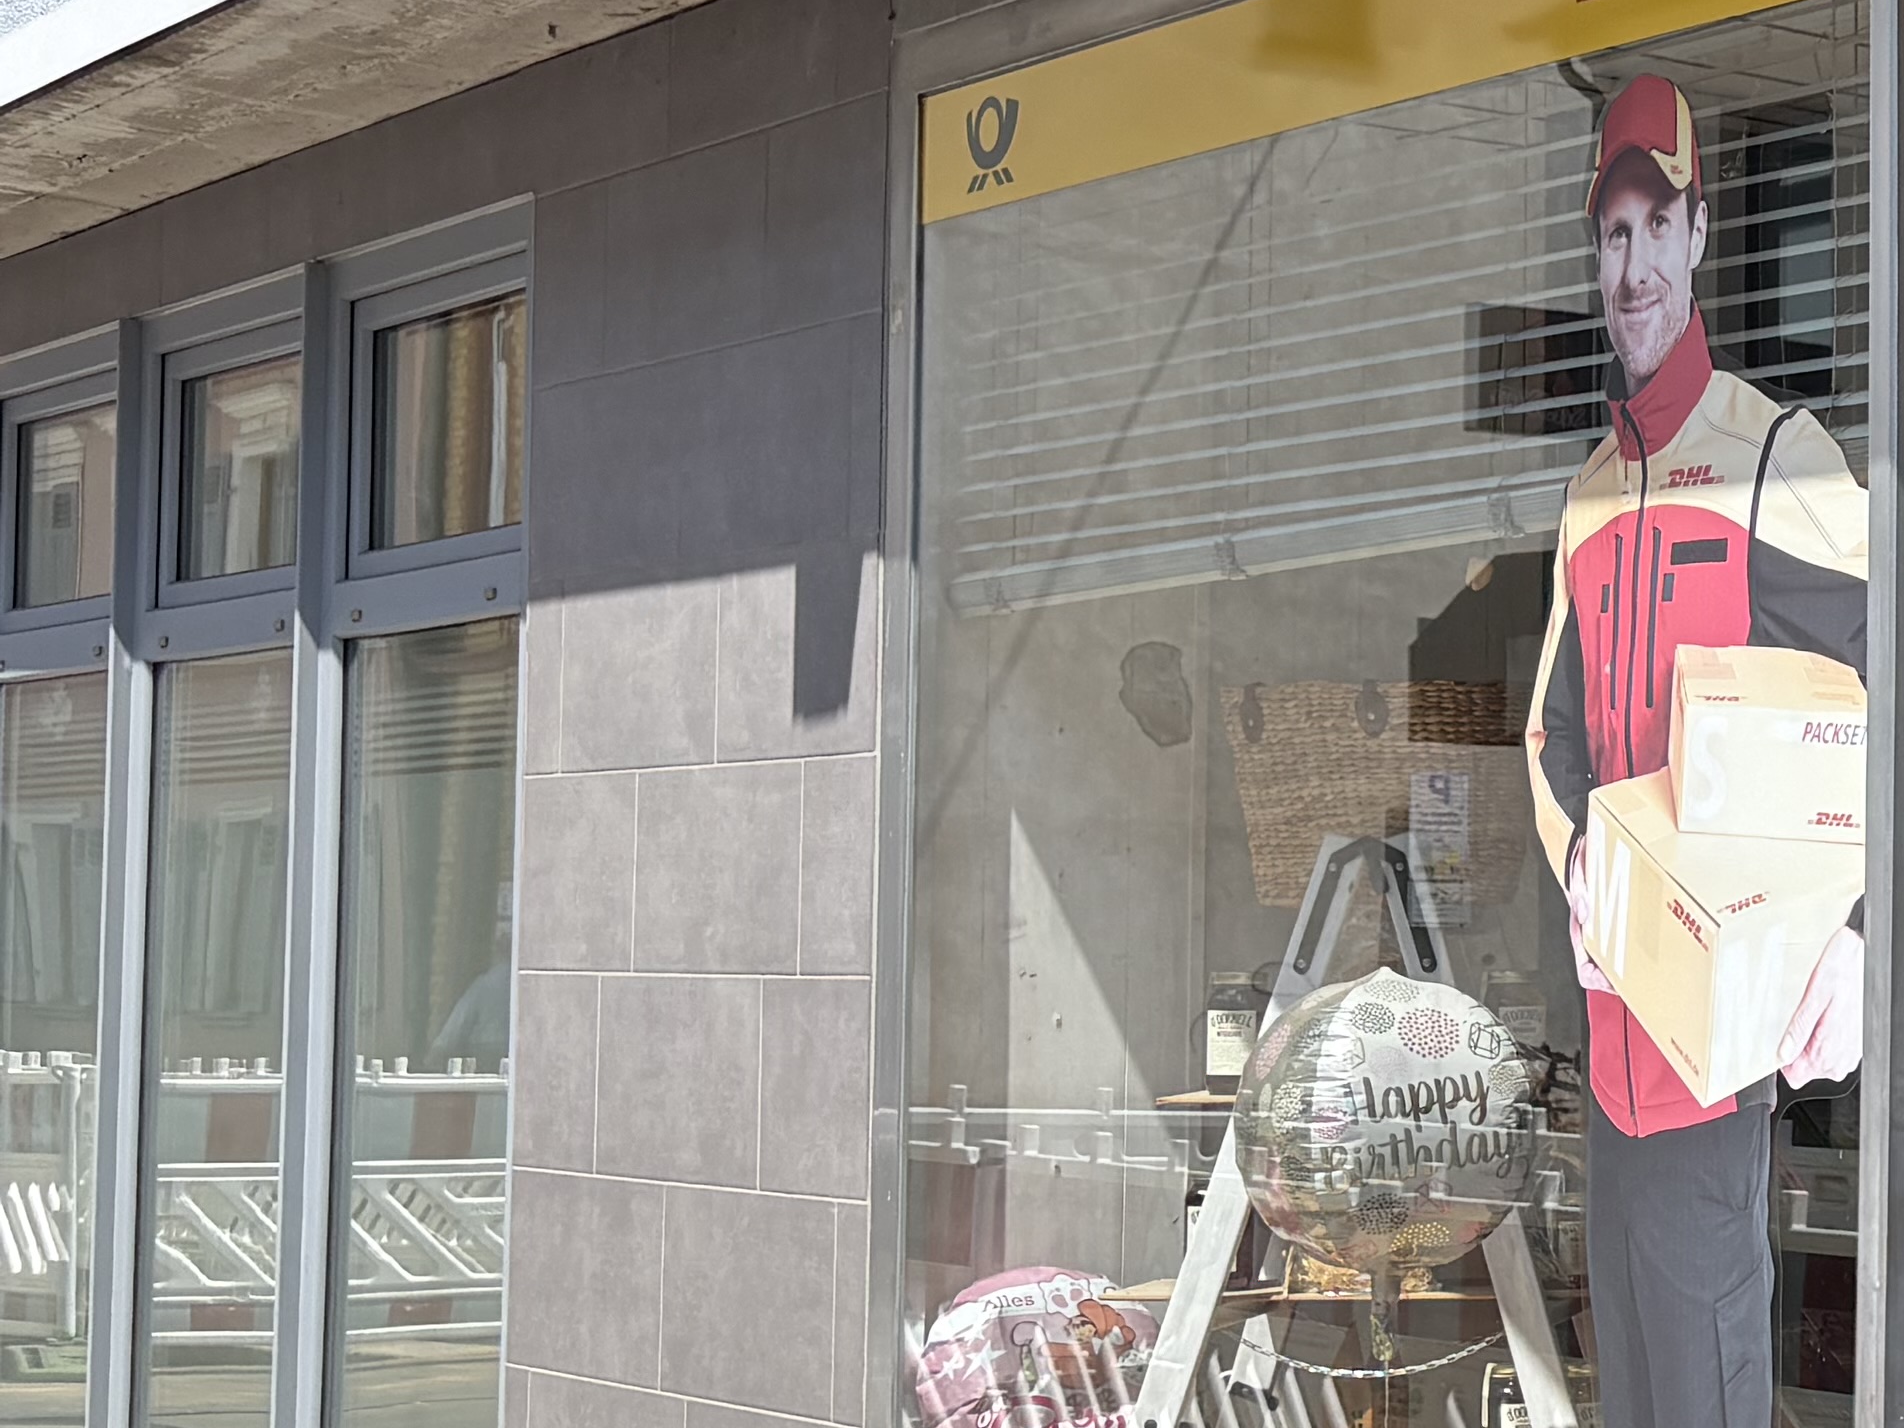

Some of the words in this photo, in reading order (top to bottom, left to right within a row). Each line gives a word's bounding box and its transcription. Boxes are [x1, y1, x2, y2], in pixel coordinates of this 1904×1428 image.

[1668, 464, 1718, 490] DHL
[1813, 812, 1856, 828] DHL
[1670, 899, 1706, 949] DHL
[1348, 1070, 1490, 1126] Happy
[1319, 1120, 1517, 1193] Birthday
[982, 1294, 1035, 1313] Alles
